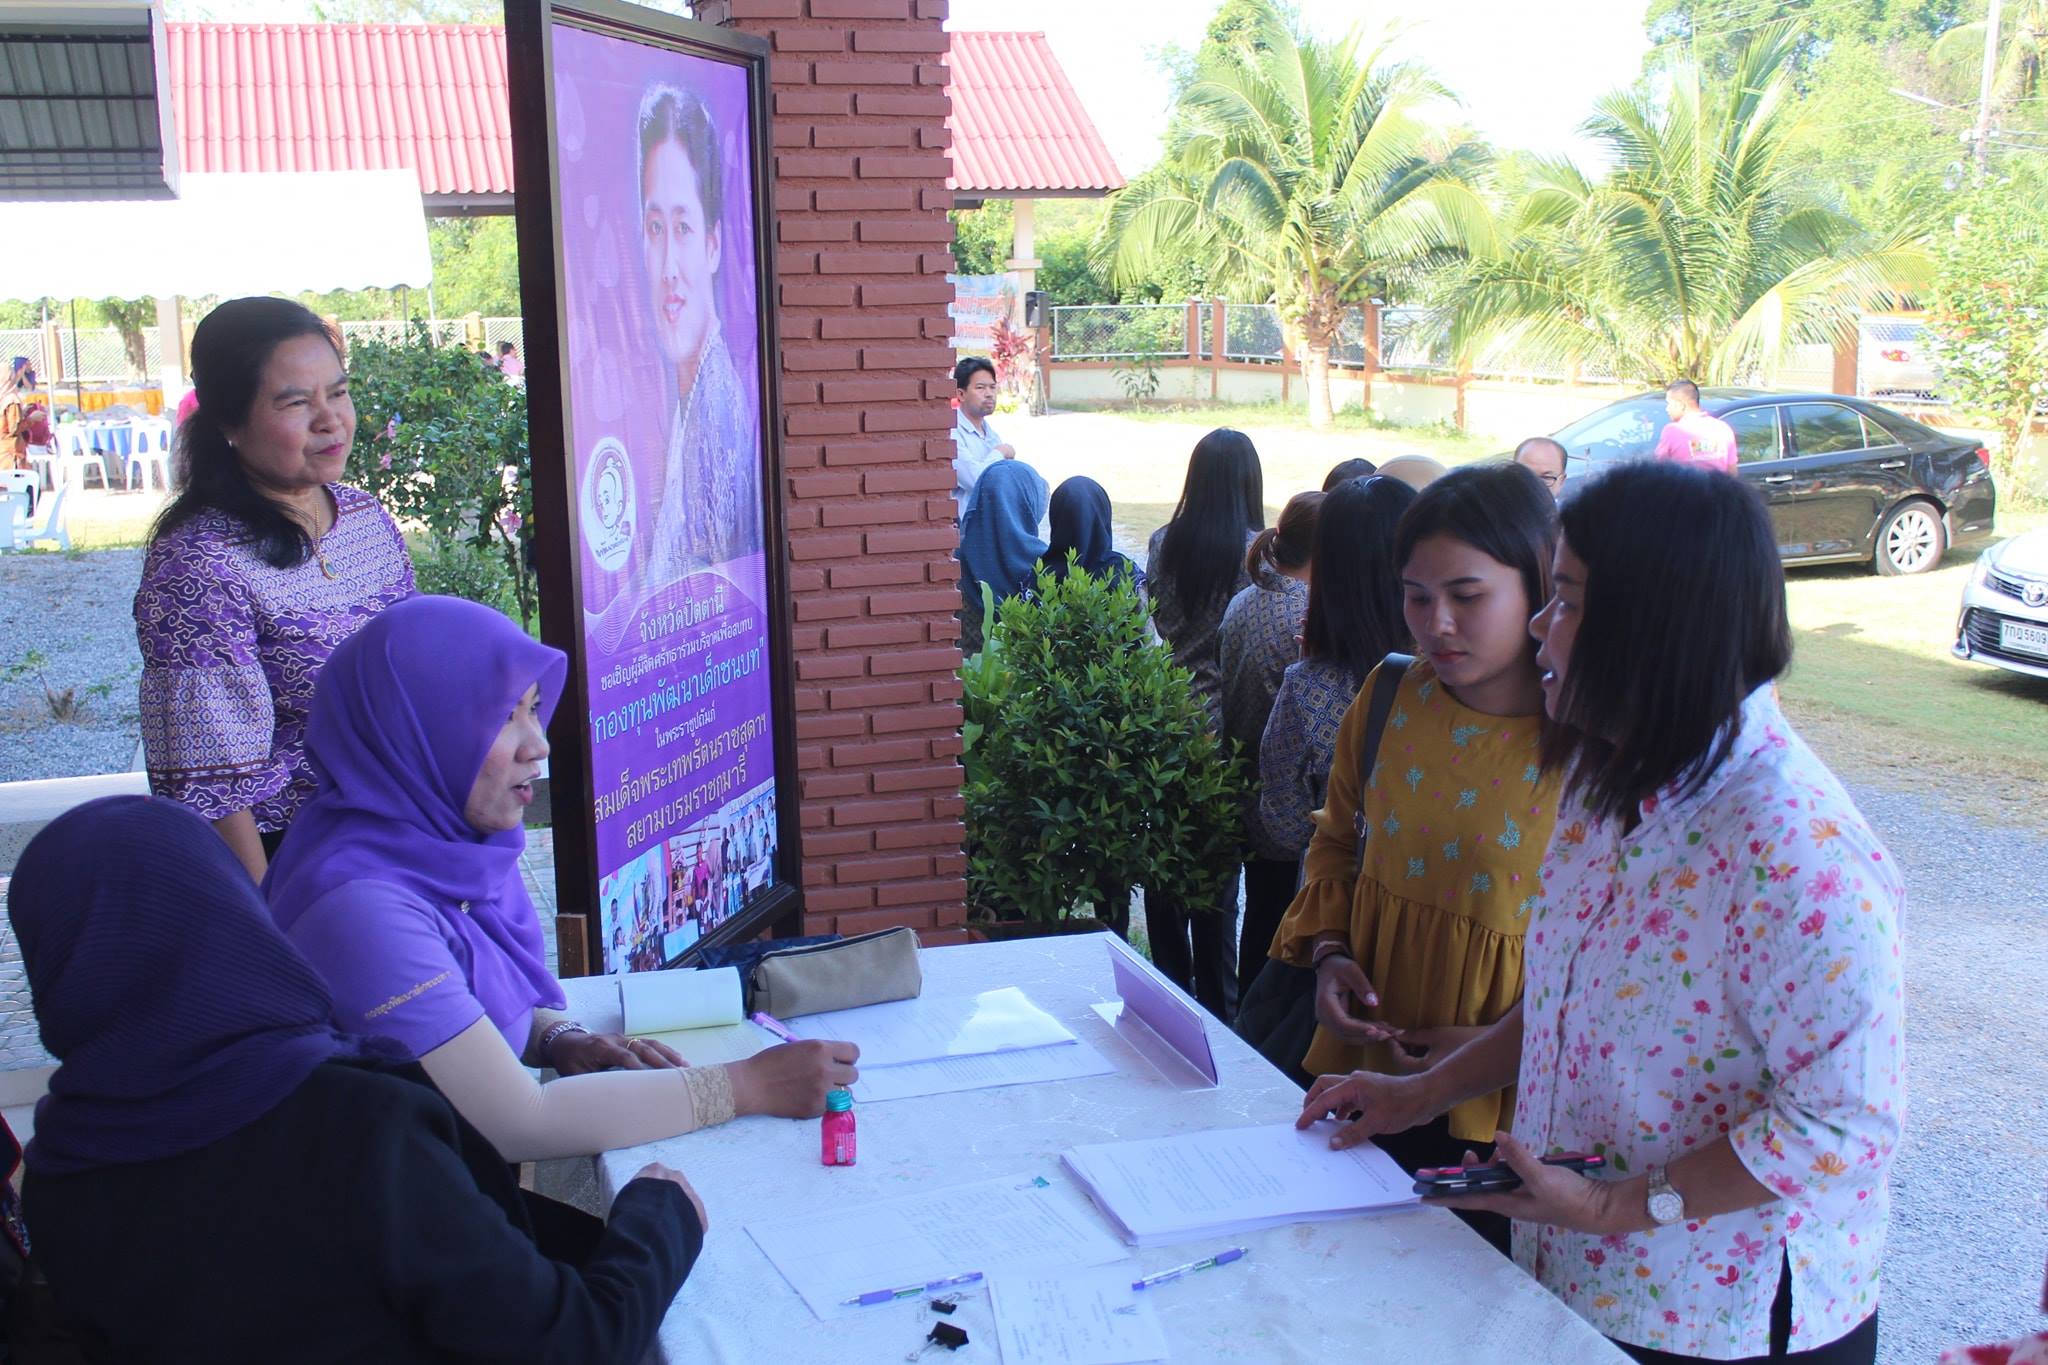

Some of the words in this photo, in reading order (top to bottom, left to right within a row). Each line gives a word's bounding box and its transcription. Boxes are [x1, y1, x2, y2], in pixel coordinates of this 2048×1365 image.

[639, 586, 725, 643] จังหวัดปัตตานี
[655, 700, 716, 748] ในพระราชูปถัมภ์
[594, 712, 767, 824] สมเด็จพระเทพรัตนราชสุดาฯ
[626, 752, 747, 849] สยามบรมราชกุมารี
